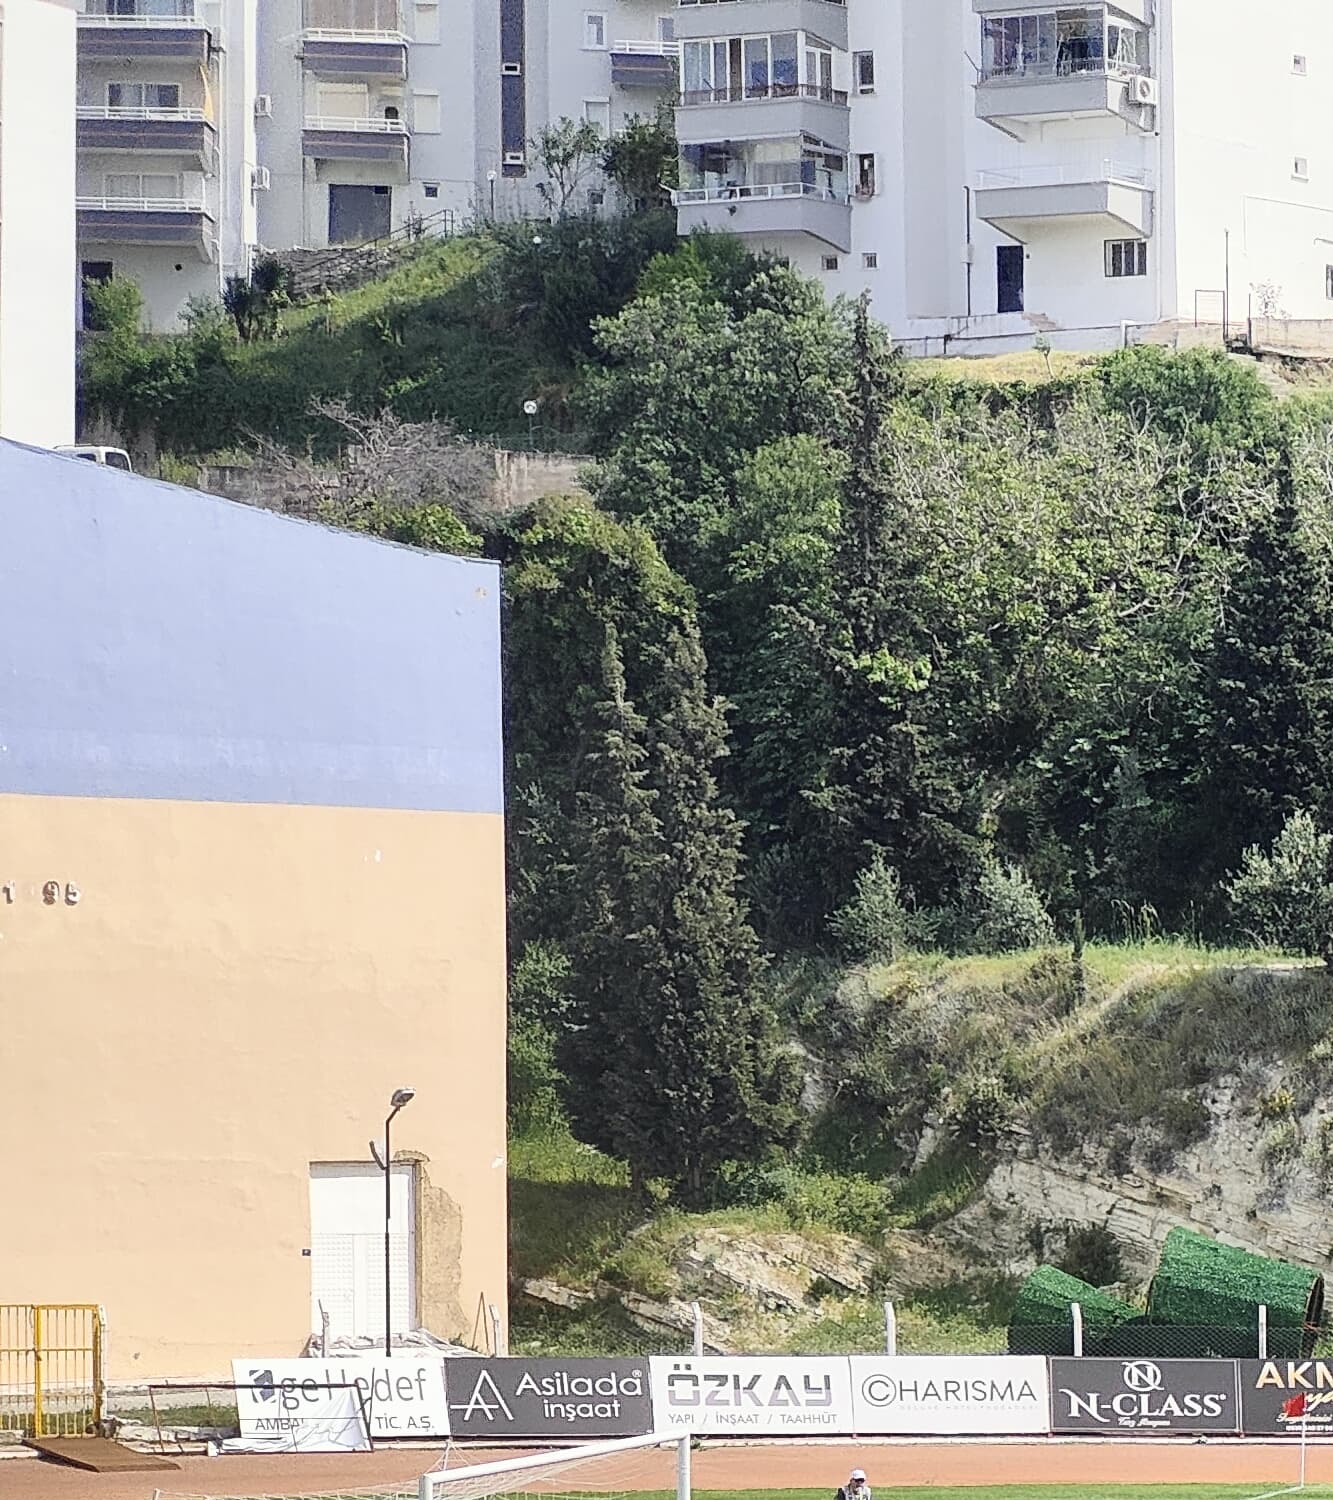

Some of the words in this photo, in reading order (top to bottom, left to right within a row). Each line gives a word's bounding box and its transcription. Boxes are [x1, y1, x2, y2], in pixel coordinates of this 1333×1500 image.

[515, 1371, 643, 1397] Asilada
[667, 1363, 832, 1407] ÖZKAY
[863, 1375, 1037, 1405] CHARISMA
[543, 1399, 621, 1422] inşaat
[668, 1413, 695, 1424] YAPI
[715, 1411, 760, 1426] İNŞAAT
[780, 1412, 838, 1425] TAAHHÜT
